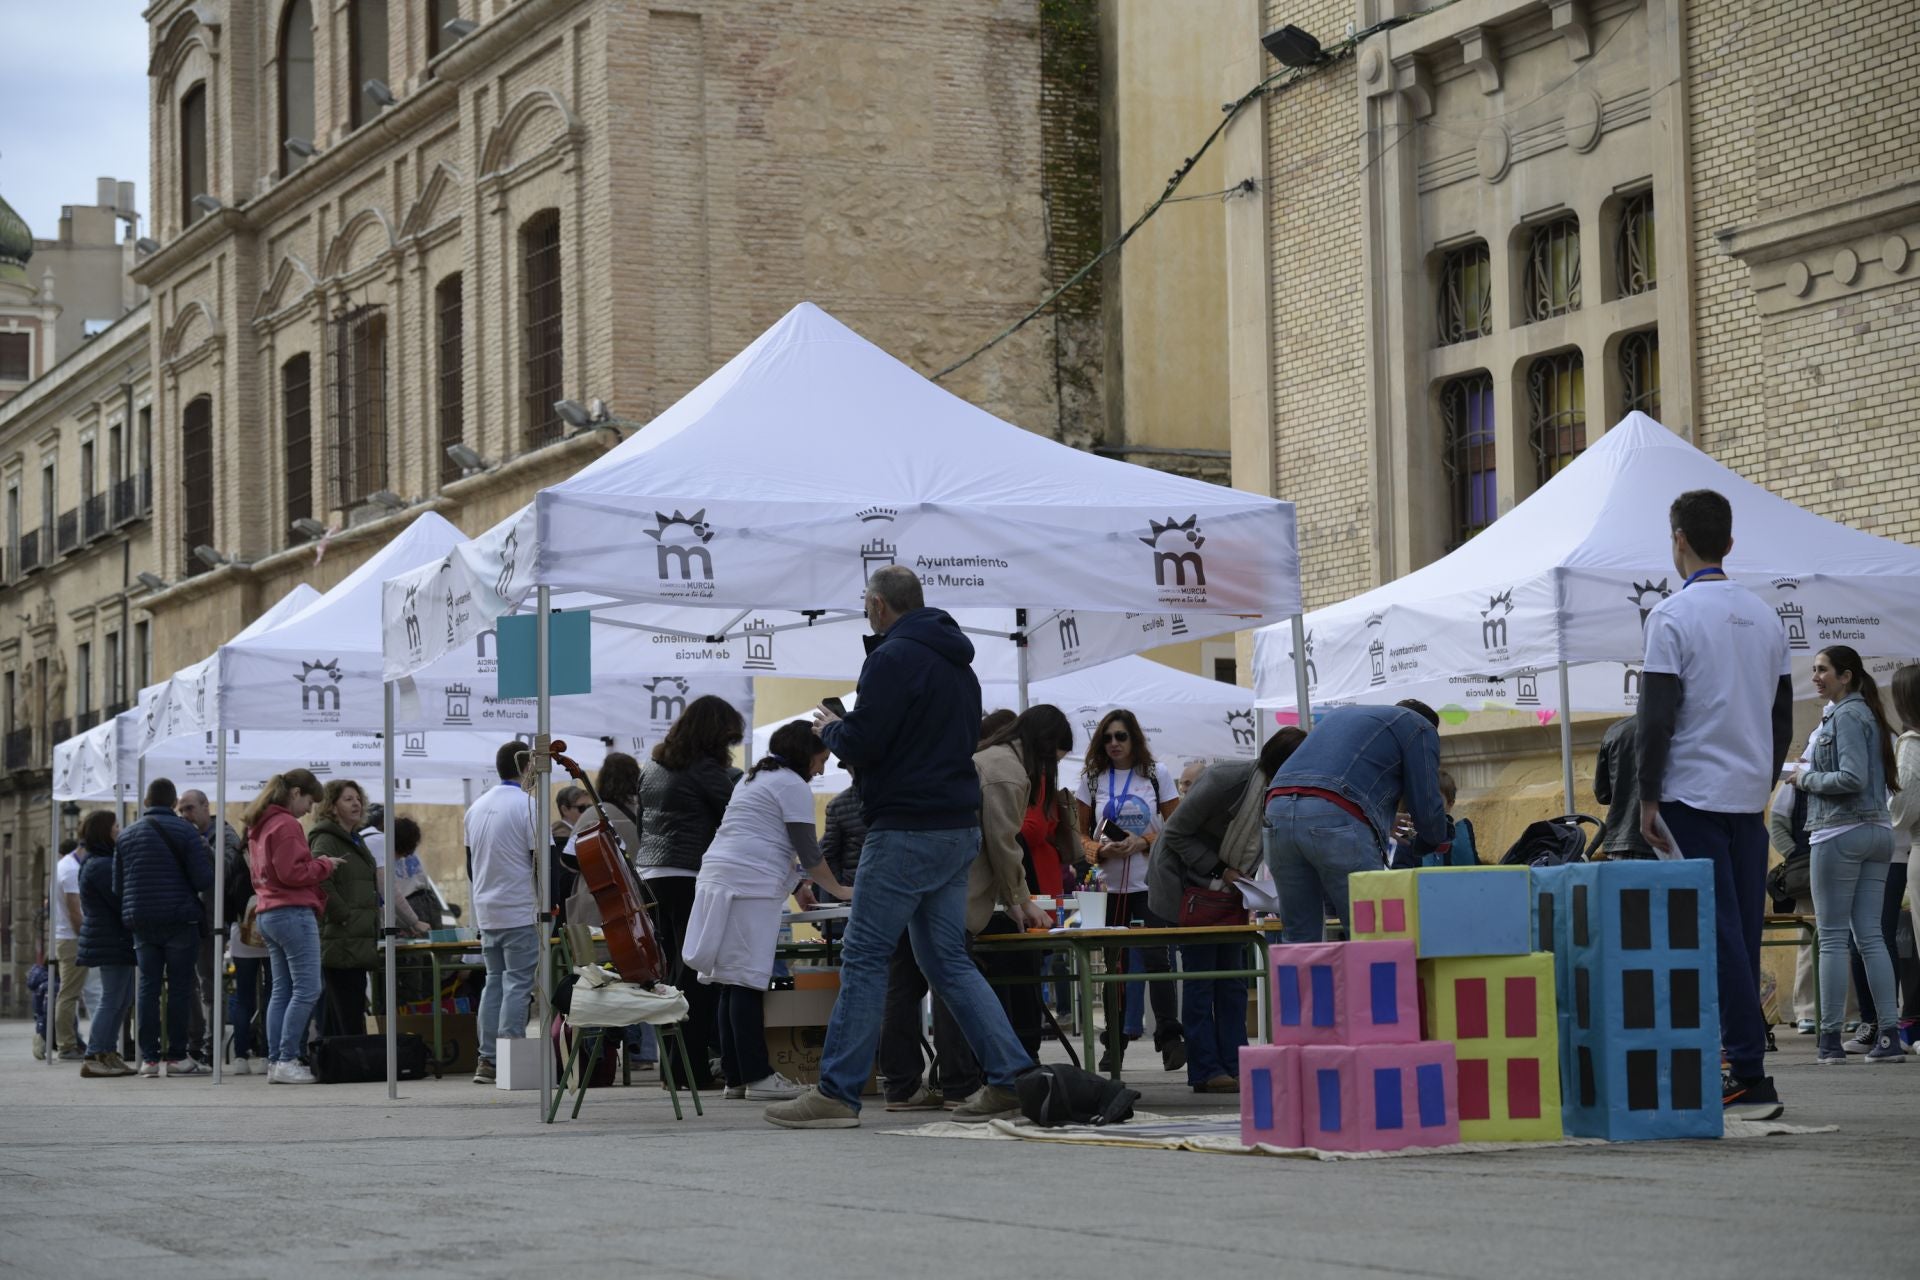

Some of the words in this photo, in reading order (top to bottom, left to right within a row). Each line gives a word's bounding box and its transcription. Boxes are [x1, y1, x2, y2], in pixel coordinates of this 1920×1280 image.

[916, 555, 1009, 569] Ayuntamiento
[919, 574, 934, 586] de
[938, 574, 984, 586] Murcia
[1817, 614, 1880, 626] Ayuntamiento
[1819, 630, 1831, 639] de
[1833, 630, 1866, 639] Murcia
[1389, 644, 1427, 658] Ayuntamiento
[1399, 659, 1418, 670] Murcia
[482, 695, 538, 706] Ayuntamien
[482, 710, 494, 718] de
[497, 710, 529, 719] Murcia
